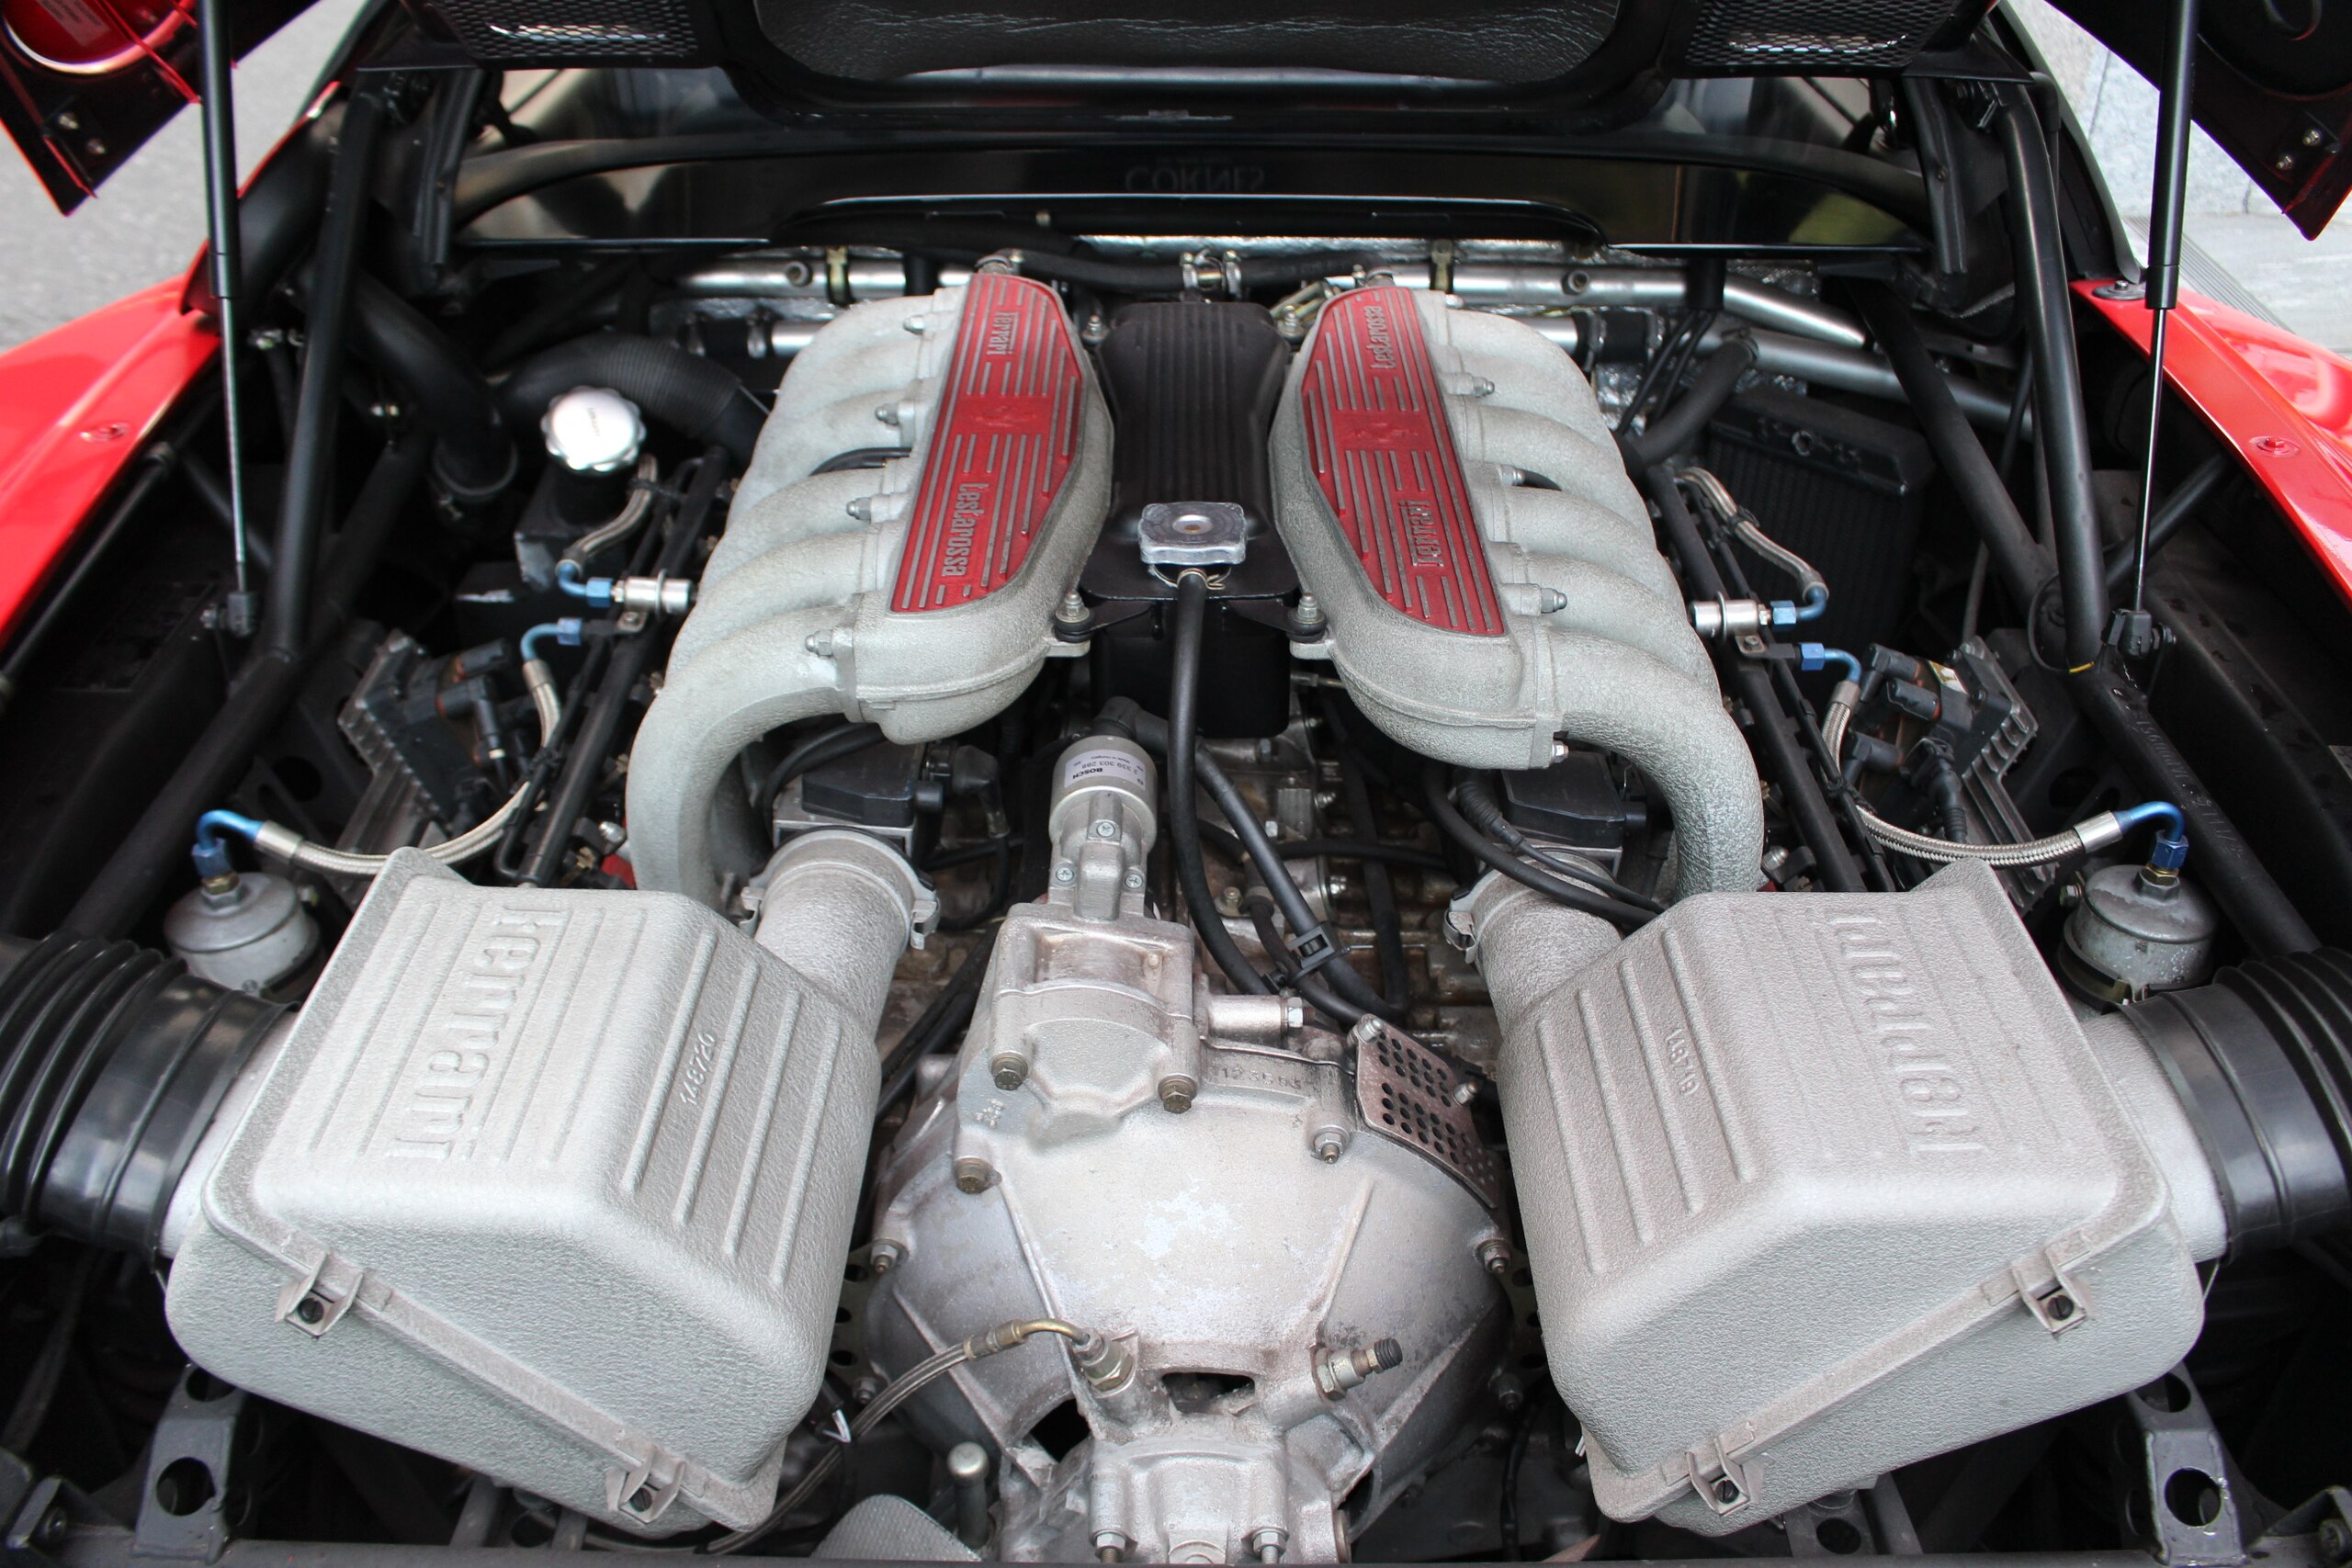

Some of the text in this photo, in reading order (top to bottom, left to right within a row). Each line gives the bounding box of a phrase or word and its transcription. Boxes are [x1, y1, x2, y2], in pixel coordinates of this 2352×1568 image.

[986, 311, 1020, 355] Ferrari
[1398, 501, 1444, 567] Ferrari
[1073, 768, 1102, 779] BOSCH
[384, 907, 572, 1159] Ferrari
